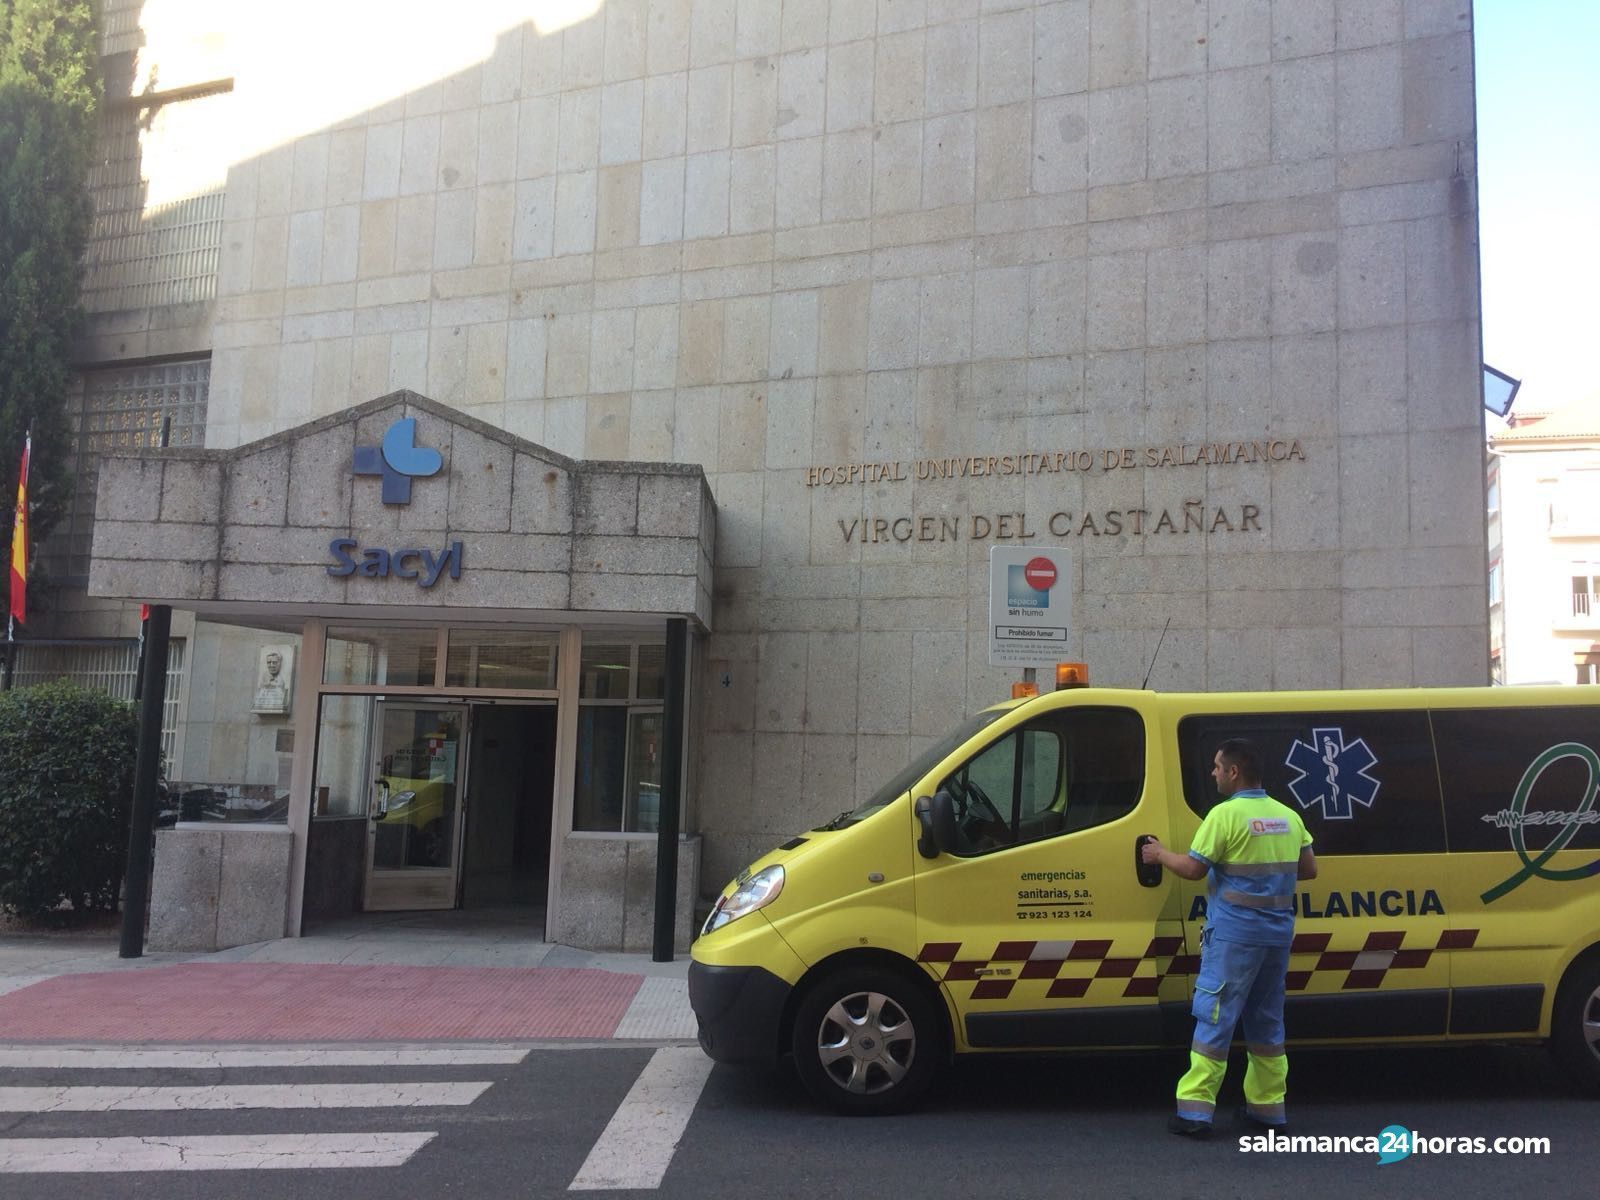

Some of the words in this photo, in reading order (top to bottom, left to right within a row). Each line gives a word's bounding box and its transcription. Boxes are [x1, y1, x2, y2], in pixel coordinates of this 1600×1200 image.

[806, 461, 907, 487] HOSPITAL
[916, 451, 1093, 480] UNIVERSITARIO
[1103, 448, 1136, 471] DE
[1146, 440, 1306, 468] SALAMANCA
[838, 516, 960, 543] VIRGEN
[971, 512, 1036, 540] DEL
[1048, 499, 1263, 537] CASTAÑAR
[326, 538, 464, 588] Sacyl
[1008, 608, 1020, 616] sin
[1021, 608, 1044, 617] humo
[1008, 629, 1037, 637] Prohibido
[1037, 629, 1054, 637] fumar
[1021, 869, 1086, 883] emergencias
[1018, 888, 1071, 900] sanitarias,
[1074, 889, 1092, 898] s.a.
[1188, 889, 1445, 922] ALANCIA
[1029, 911, 1048, 919] 923
[1073, 910, 1092, 918] 124
